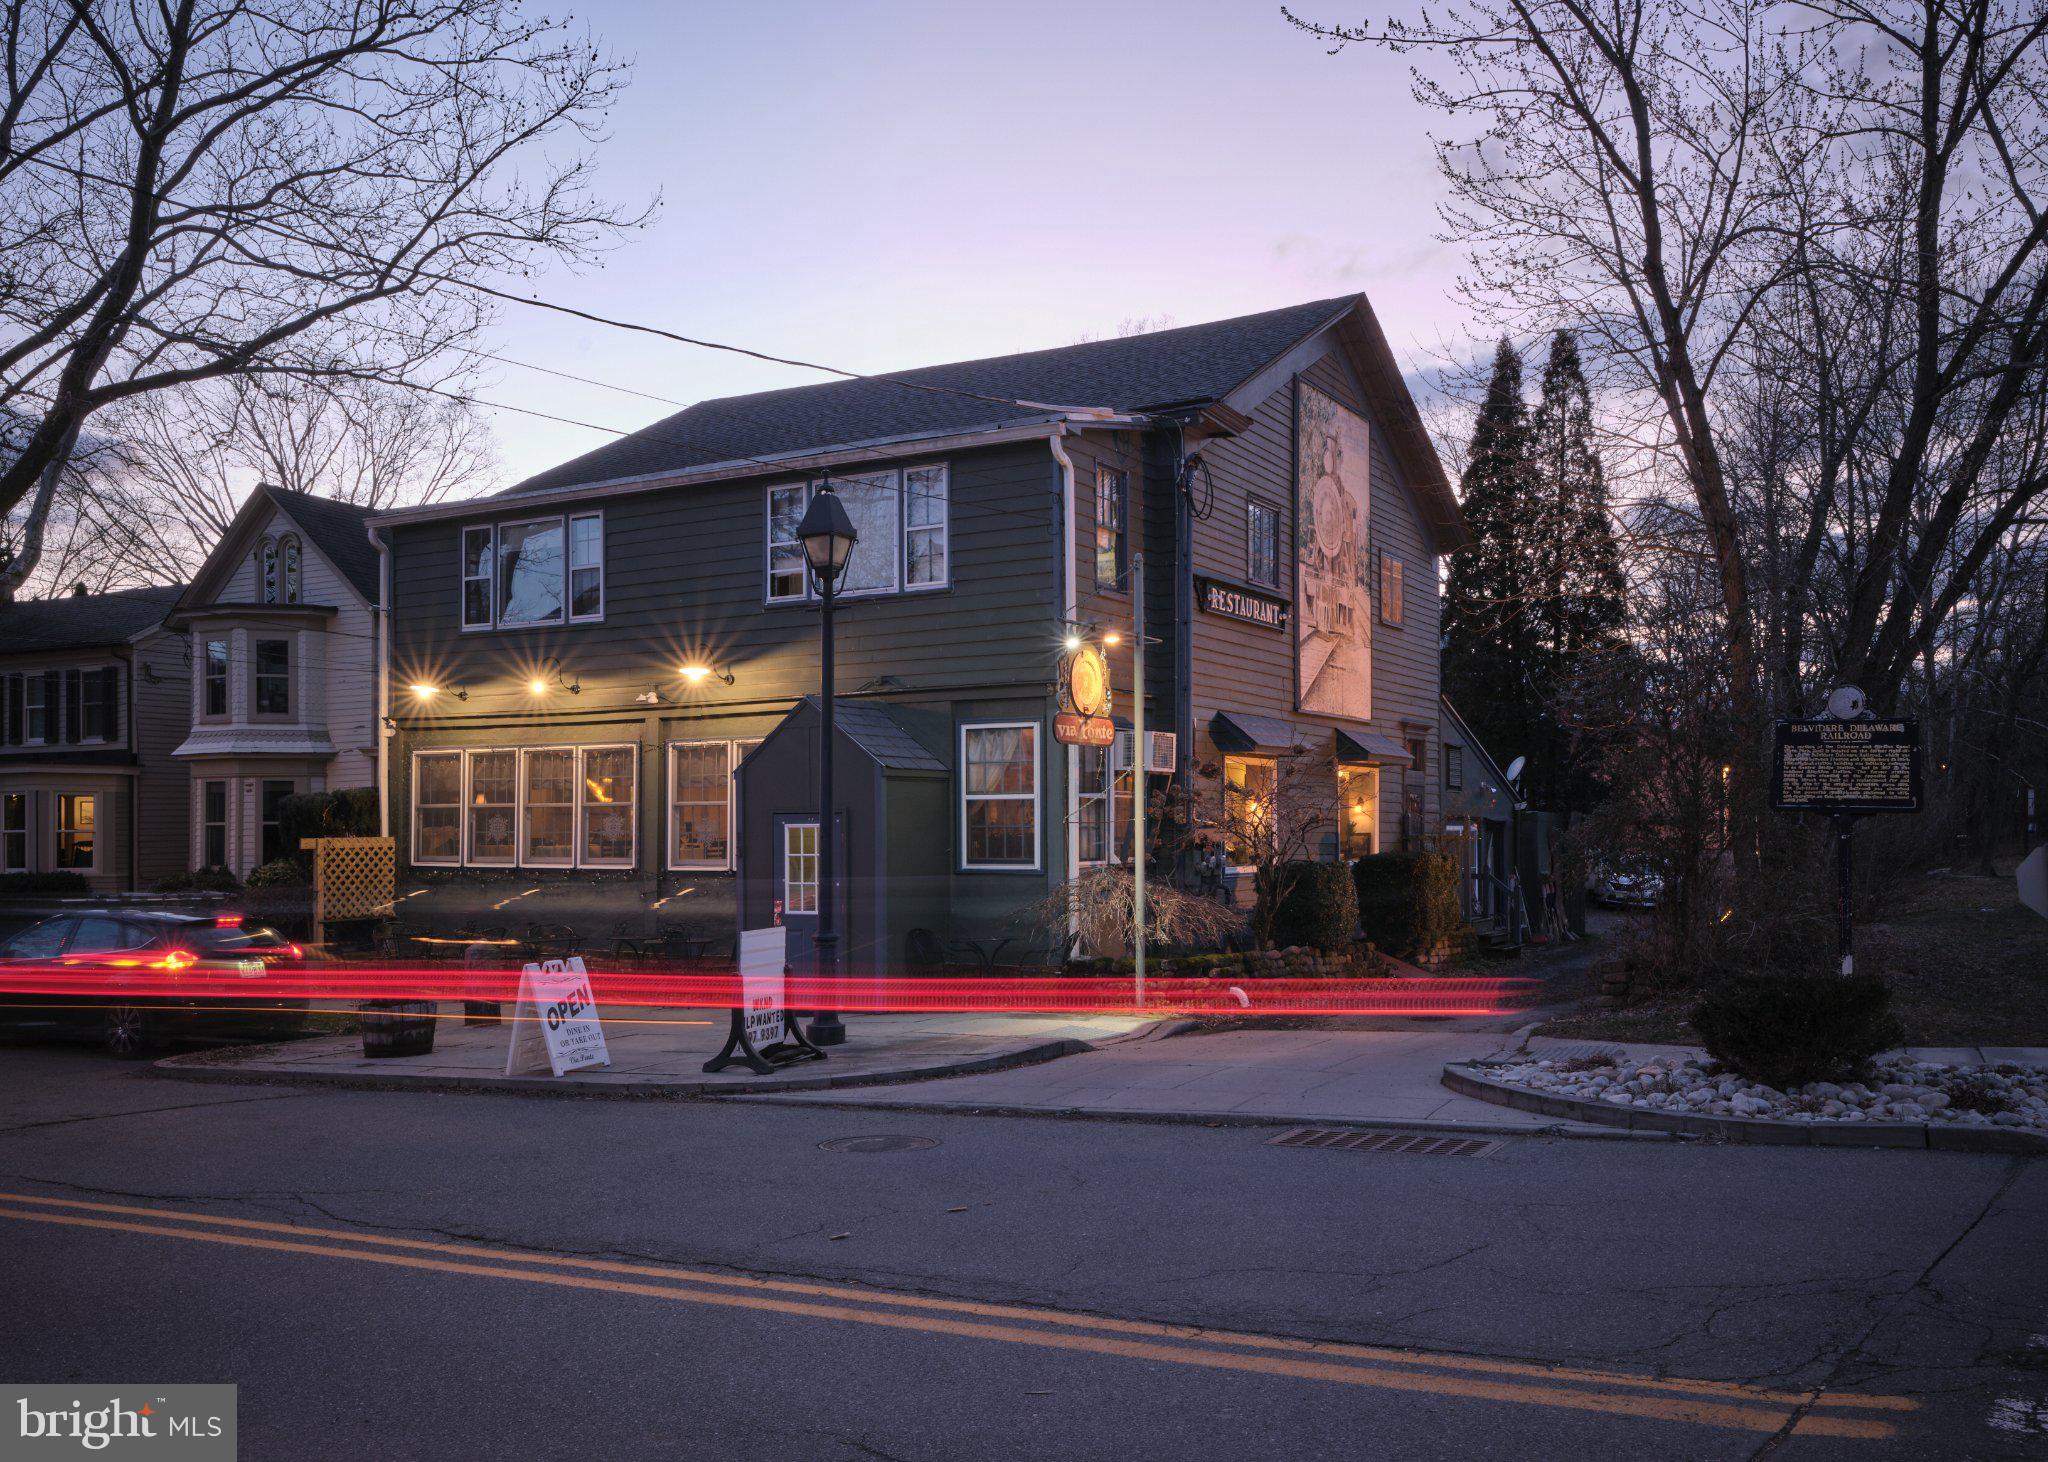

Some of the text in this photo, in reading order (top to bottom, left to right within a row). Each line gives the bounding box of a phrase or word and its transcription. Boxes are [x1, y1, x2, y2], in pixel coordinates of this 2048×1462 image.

[1208, 587, 1280, 624] RESTAURANT
[1791, 723, 1904, 732] BELVIDERE DELAWARE
[1820, 732, 1872, 740] RAILROAD
[547, 983, 590, 1031] OPEN
[752, 996, 773, 1011] WKND
[566, 1024, 591, 1036] DINE IN
[560, 1033, 601, 1047] OR TAKE OUT
